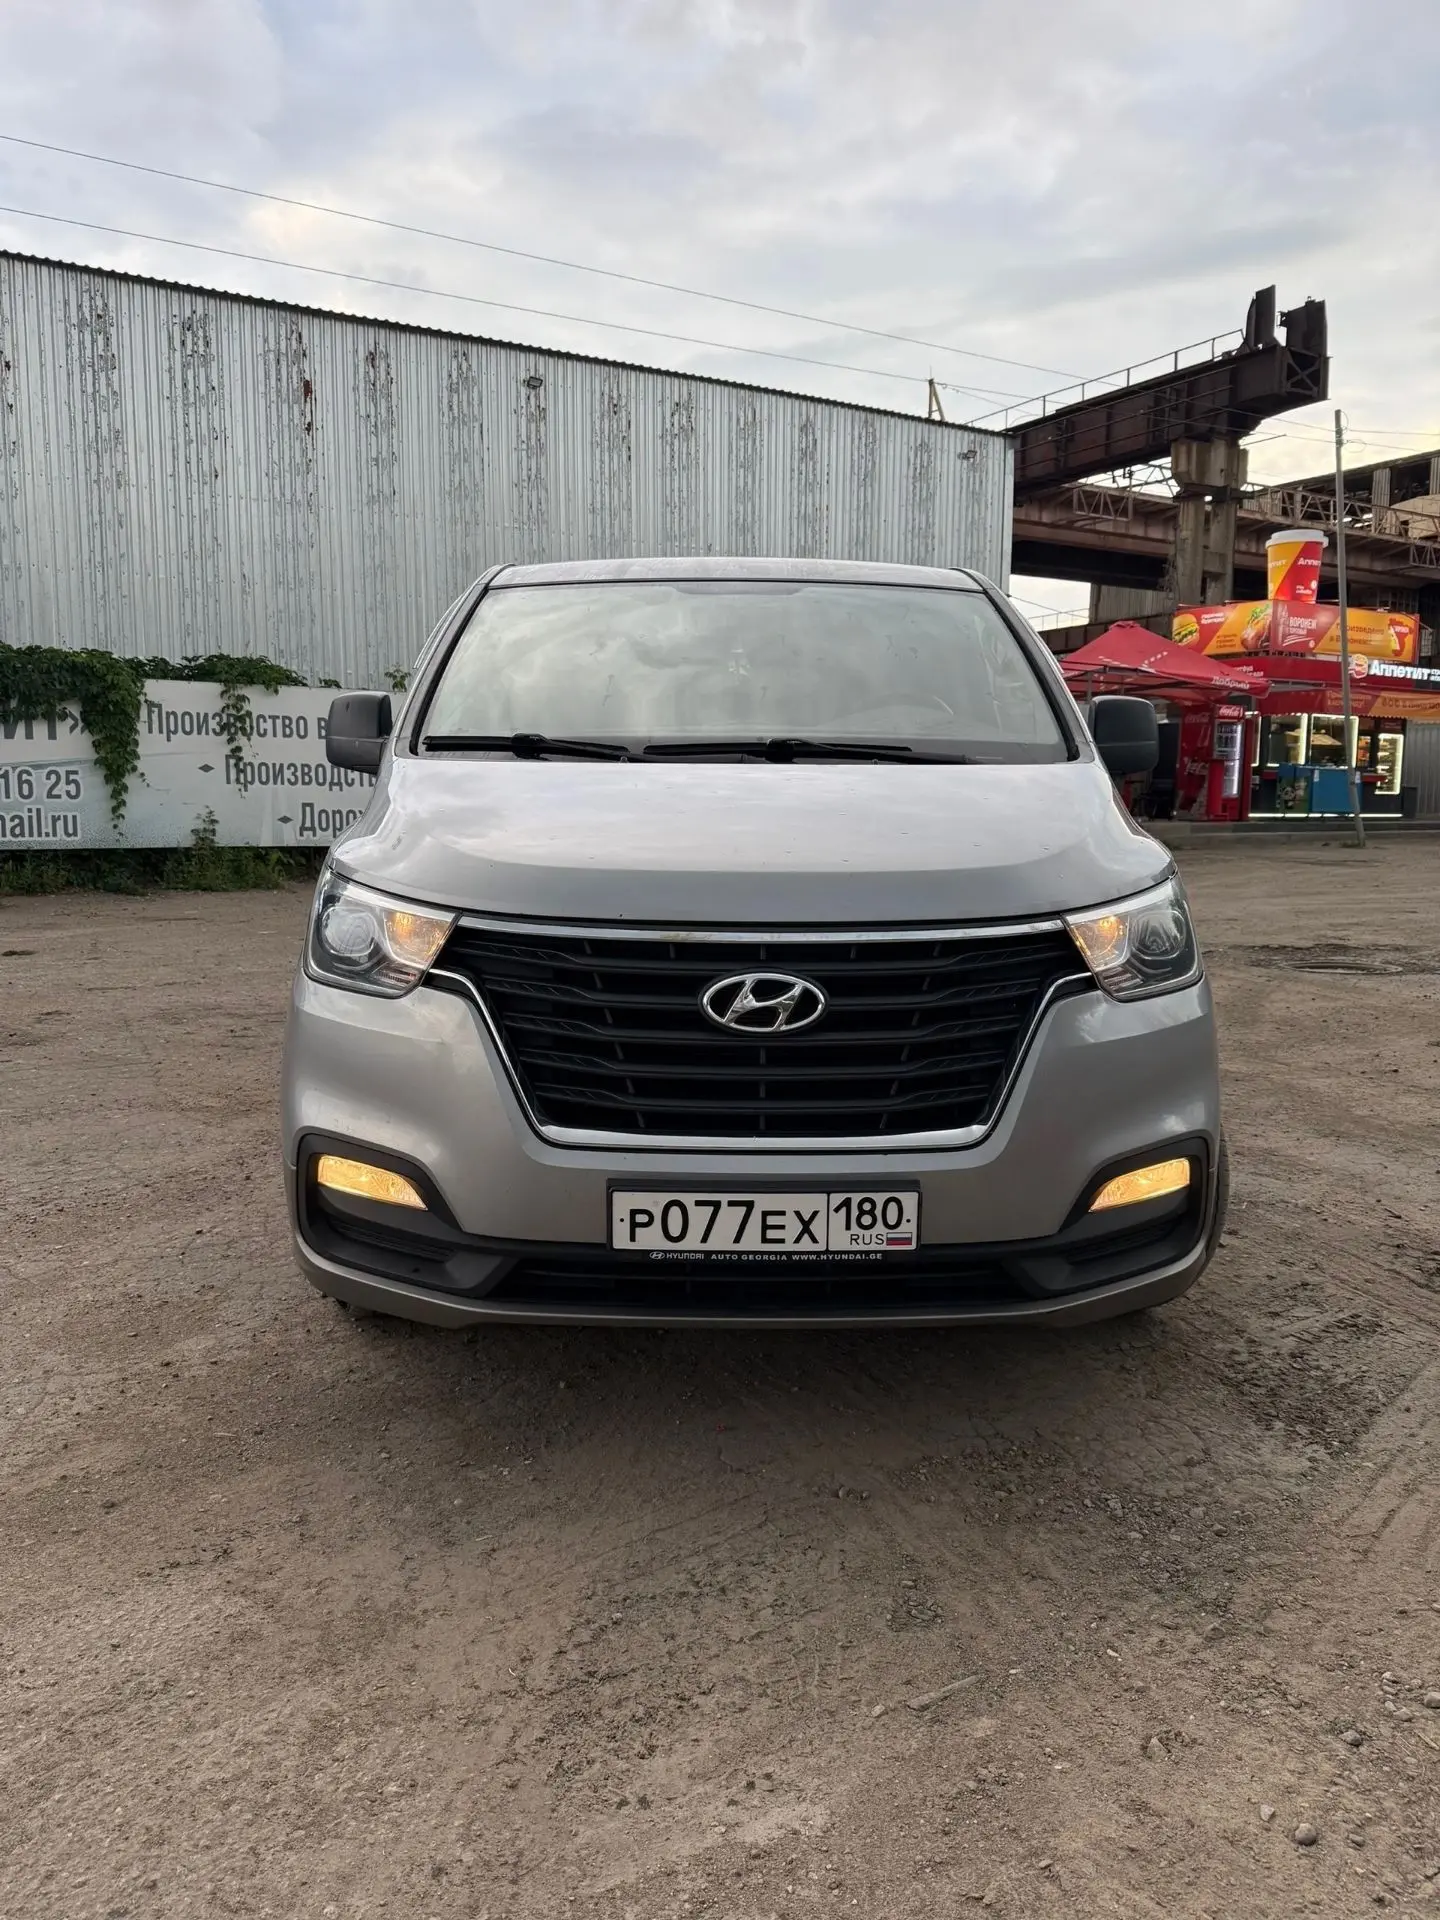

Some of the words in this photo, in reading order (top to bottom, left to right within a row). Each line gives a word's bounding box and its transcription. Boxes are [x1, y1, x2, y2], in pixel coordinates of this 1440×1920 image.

[1369, 660, 1431, 681] Аппетит
[45, 770, 82, 800] 25
[299, 802, 363, 838] Доро
[629, 1199, 820, 1244] Р077ЕХ
[833, 1196, 904, 1231] 180
[849, 1233, 885, 1246] RUS
[711, 1253, 738, 1261] AUTO
[791, 1253, 883, 1261] WWW.HYUNDAI.GE
